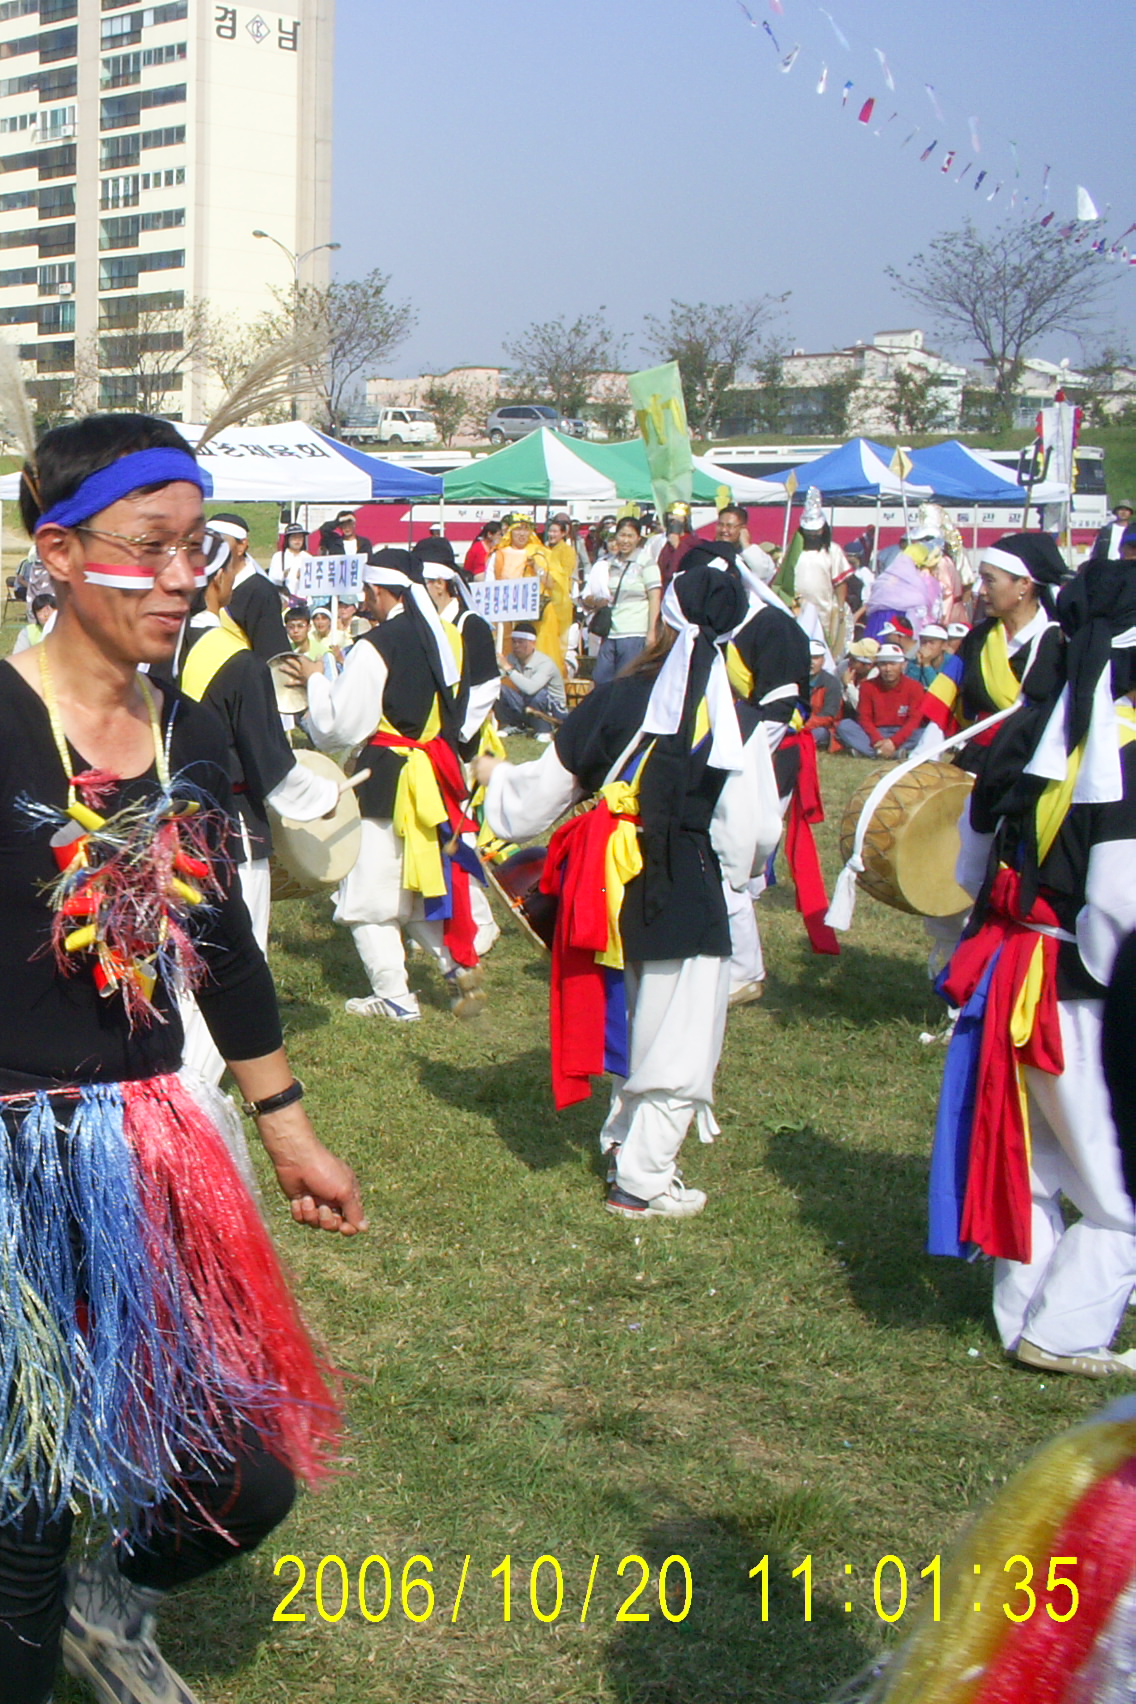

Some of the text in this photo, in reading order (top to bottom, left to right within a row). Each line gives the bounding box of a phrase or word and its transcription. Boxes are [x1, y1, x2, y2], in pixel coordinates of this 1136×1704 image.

[214, 5, 301, 52] 경 남
[304, 559, 359, 589] 진주복지원
